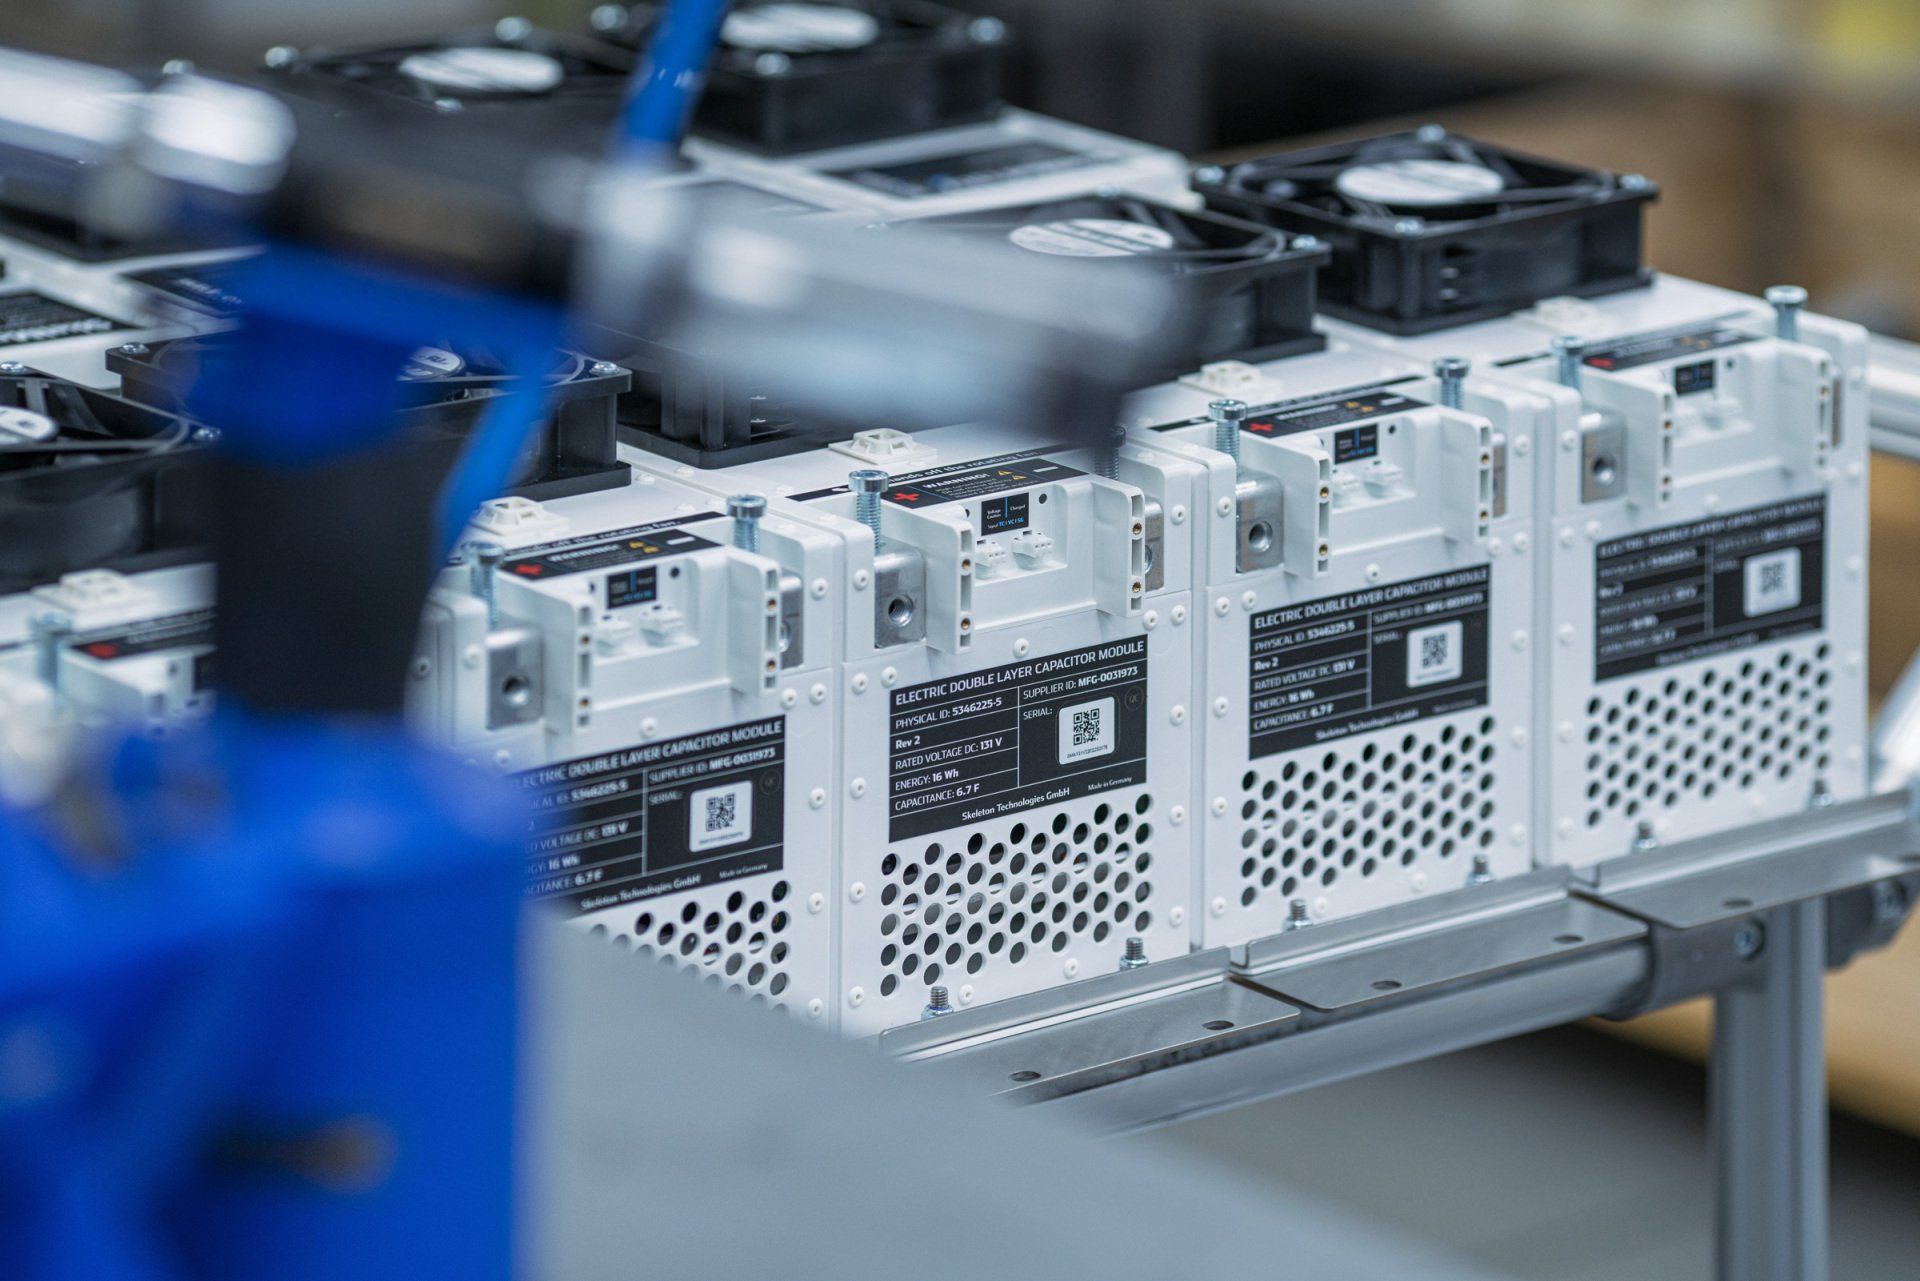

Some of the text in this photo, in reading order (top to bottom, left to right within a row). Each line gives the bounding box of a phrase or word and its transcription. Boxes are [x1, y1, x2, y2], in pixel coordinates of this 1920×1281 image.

[926, 468, 944, 478] off
[943, 464, 968, 474] the
[968, 454, 1018, 470] rotating
[923, 472, 991, 489] WARNING!
[1254, 607, 1304, 630] ELECTRIC
[1304, 598, 1348, 618] DOUBLE
[1348, 590, 1384, 609] LAYER
[1383, 579, 1444, 601] CAPACITOR
[895, 640, 1145, 706] ELECTRIC DOUBLE LAYER CAPACITOR MODULE
[1254, 656, 1279, 672] Rev 2
[1023, 666, 1138, 700] SUPPLIER ID: MFG-0031973
[895, 711, 938, 730] PHYSICAL
[939, 708, 951, 720] ID:
[1022, 706, 1053, 721] SERIAL:
[567, 753, 620, 778] DOUBLE
[620, 745, 660, 767] LAYER
[662, 731, 731, 758] CAPACITOR
[731, 720, 783, 743] MODULE
[895, 735, 921, 750] Rev 2
[895, 736, 1003, 770] RATED VOLTAGE DC: 131 V
[648, 763, 695, 785] SUPPLIER
[895, 768, 959, 791] ENERGY: 16 Wh
[895, 783, 980, 811] CAPACITANCE: 6.7 F
[1087, 783, 1102, 792] Made
[962, 786, 1070, 821] Skeleton Technologies GmbH
[619, 881, 673, 901] Technologies
